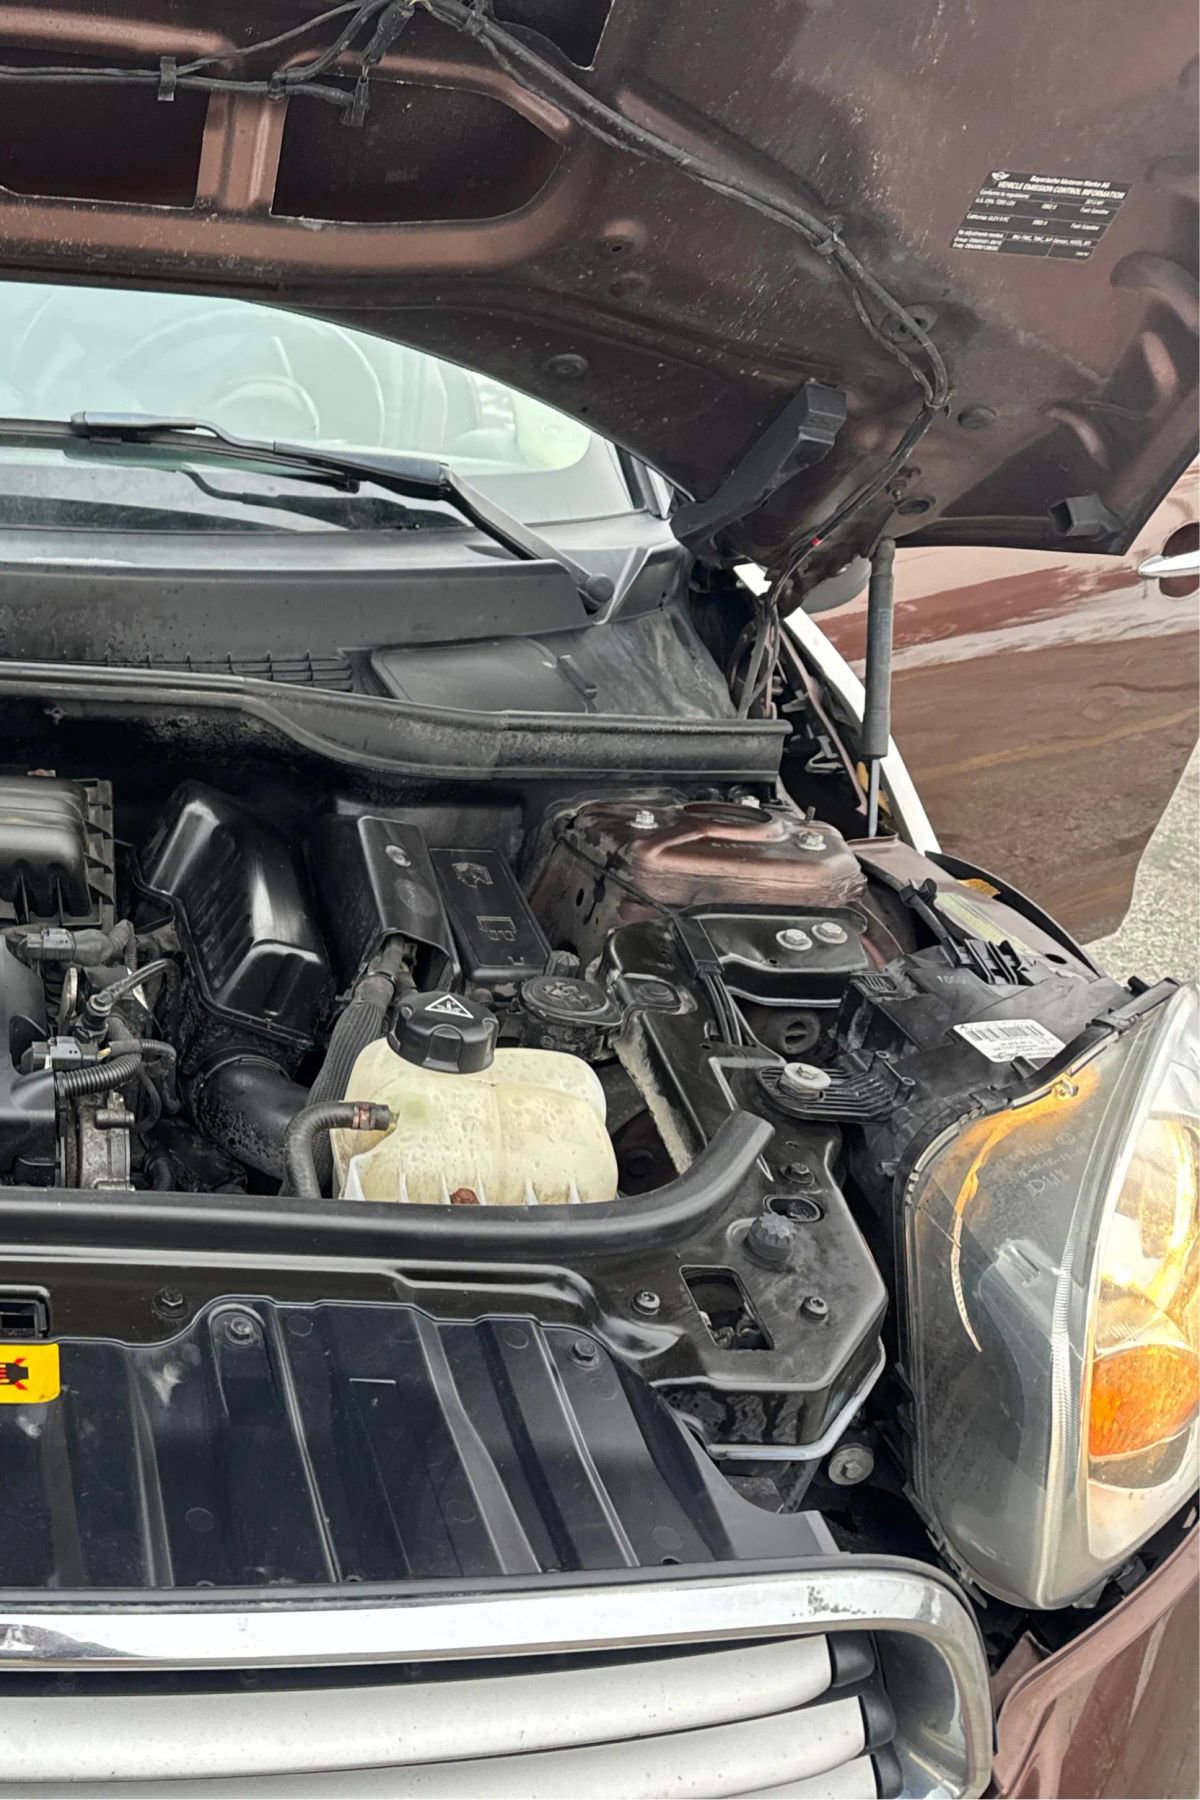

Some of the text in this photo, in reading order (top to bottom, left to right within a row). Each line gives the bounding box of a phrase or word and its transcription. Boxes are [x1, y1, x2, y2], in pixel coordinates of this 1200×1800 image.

[998, 181, 1127, 200] VEHICLE EMISSION CONTROL INFORMATION
